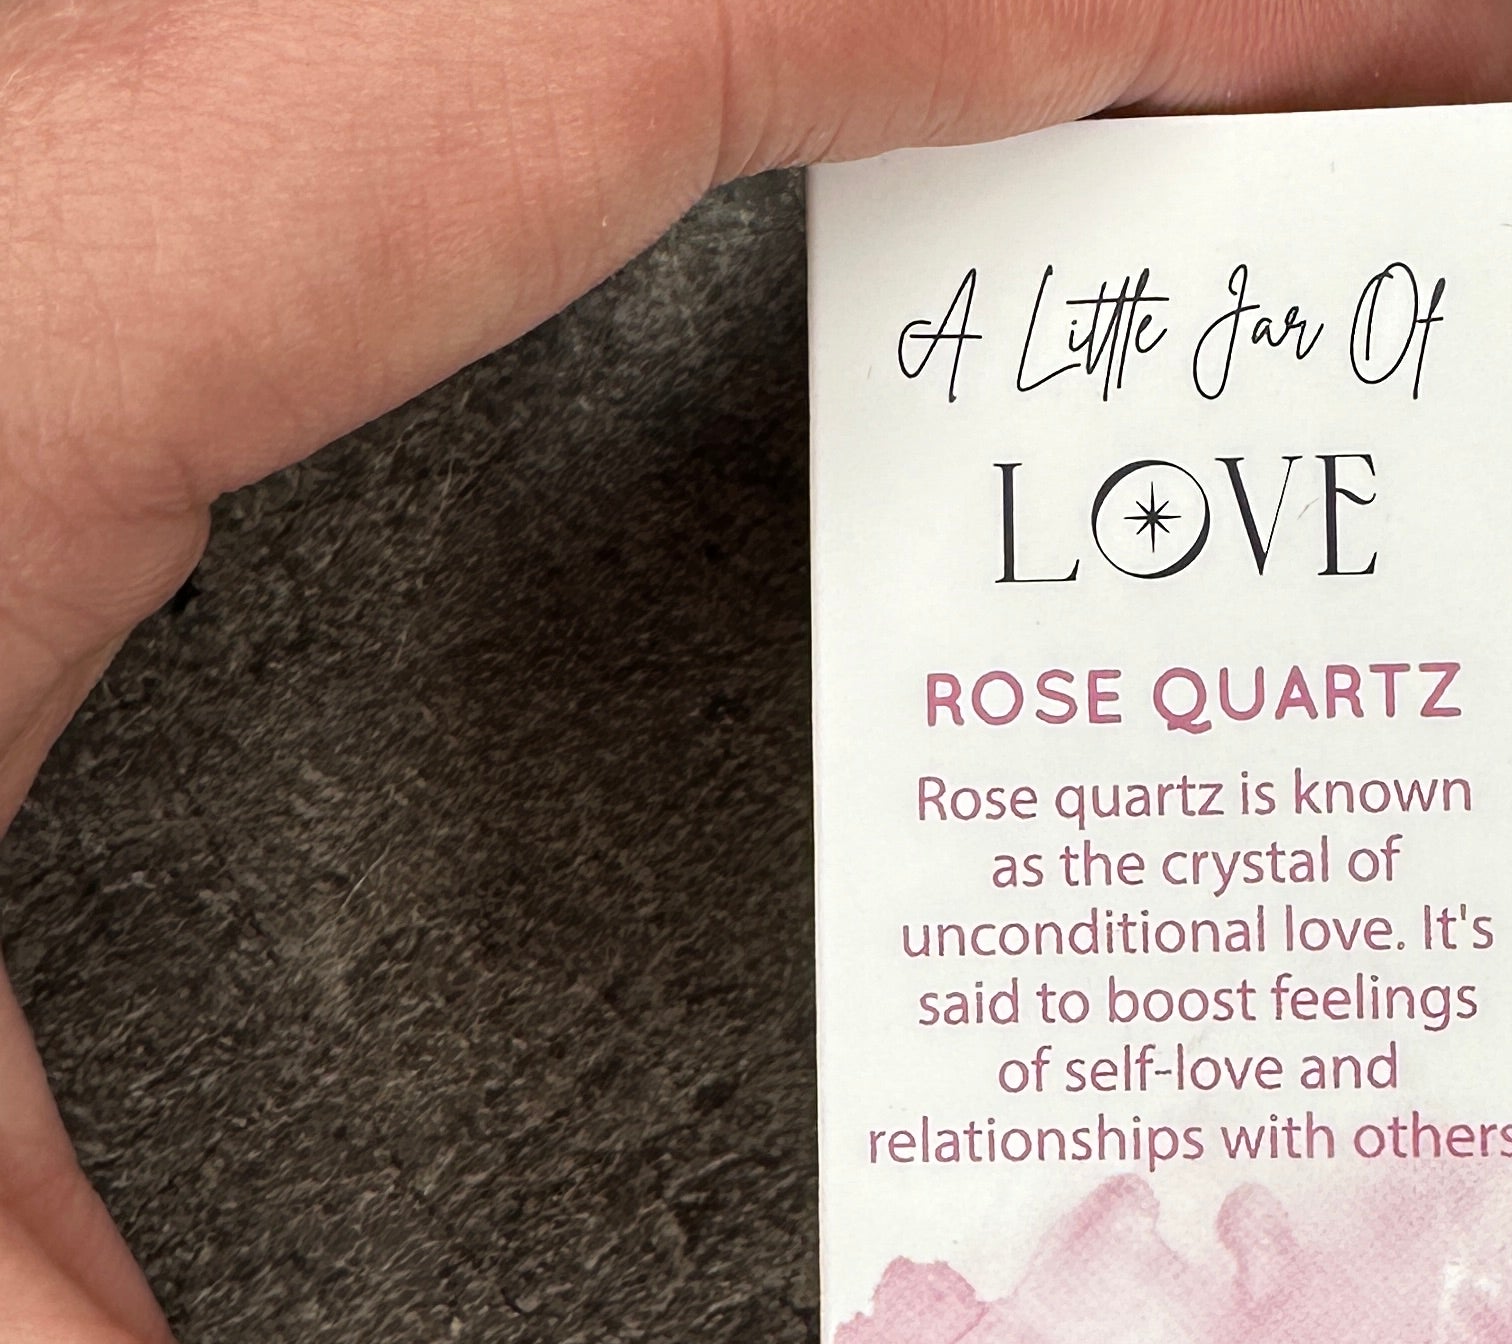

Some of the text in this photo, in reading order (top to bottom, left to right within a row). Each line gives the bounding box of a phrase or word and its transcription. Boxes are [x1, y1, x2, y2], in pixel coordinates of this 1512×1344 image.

[898, 261, 1447, 404] A Little Jar Of
[992, 453, 1378, 584] LOVE
[926, 661, 1463, 735] ROSE QUARTZ
[918, 766, 1472, 832] Rose quartz is known
[992, 833, 1404, 899] as the crystal of
[902, 903, 1494, 958] unconditional love. It's
[918, 971, 1478, 1033] said to boost feelings
[998, 1040, 1398, 1094] of self-love and
[869, 1112, 1205, 1174] relationships
[1219, 1110, 1336, 1160] with
